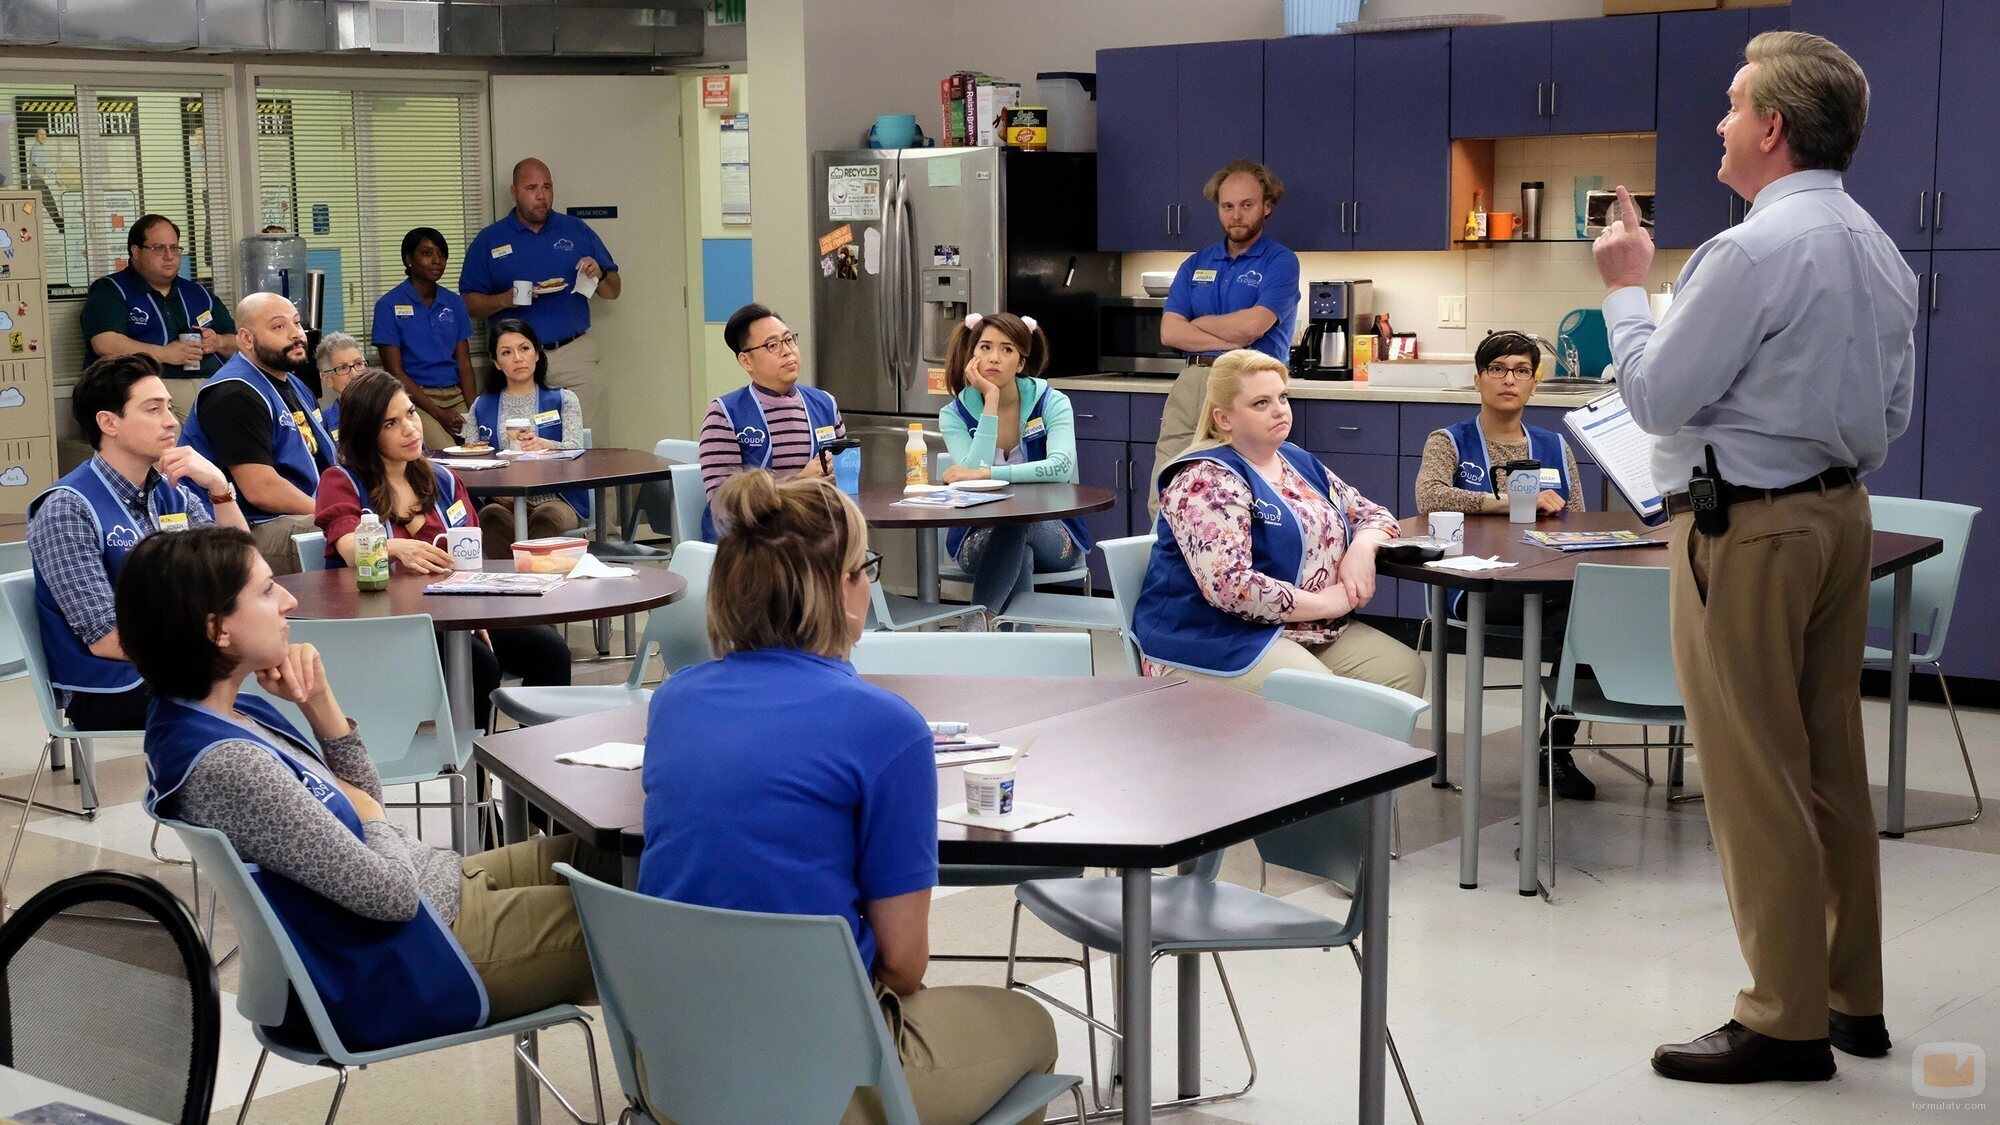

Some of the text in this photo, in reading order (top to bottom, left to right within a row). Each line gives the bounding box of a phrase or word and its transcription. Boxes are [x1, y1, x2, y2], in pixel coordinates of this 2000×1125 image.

[966, 91, 975, 135] Raisin Bran
[844, 167, 878, 178] RECYCLES
